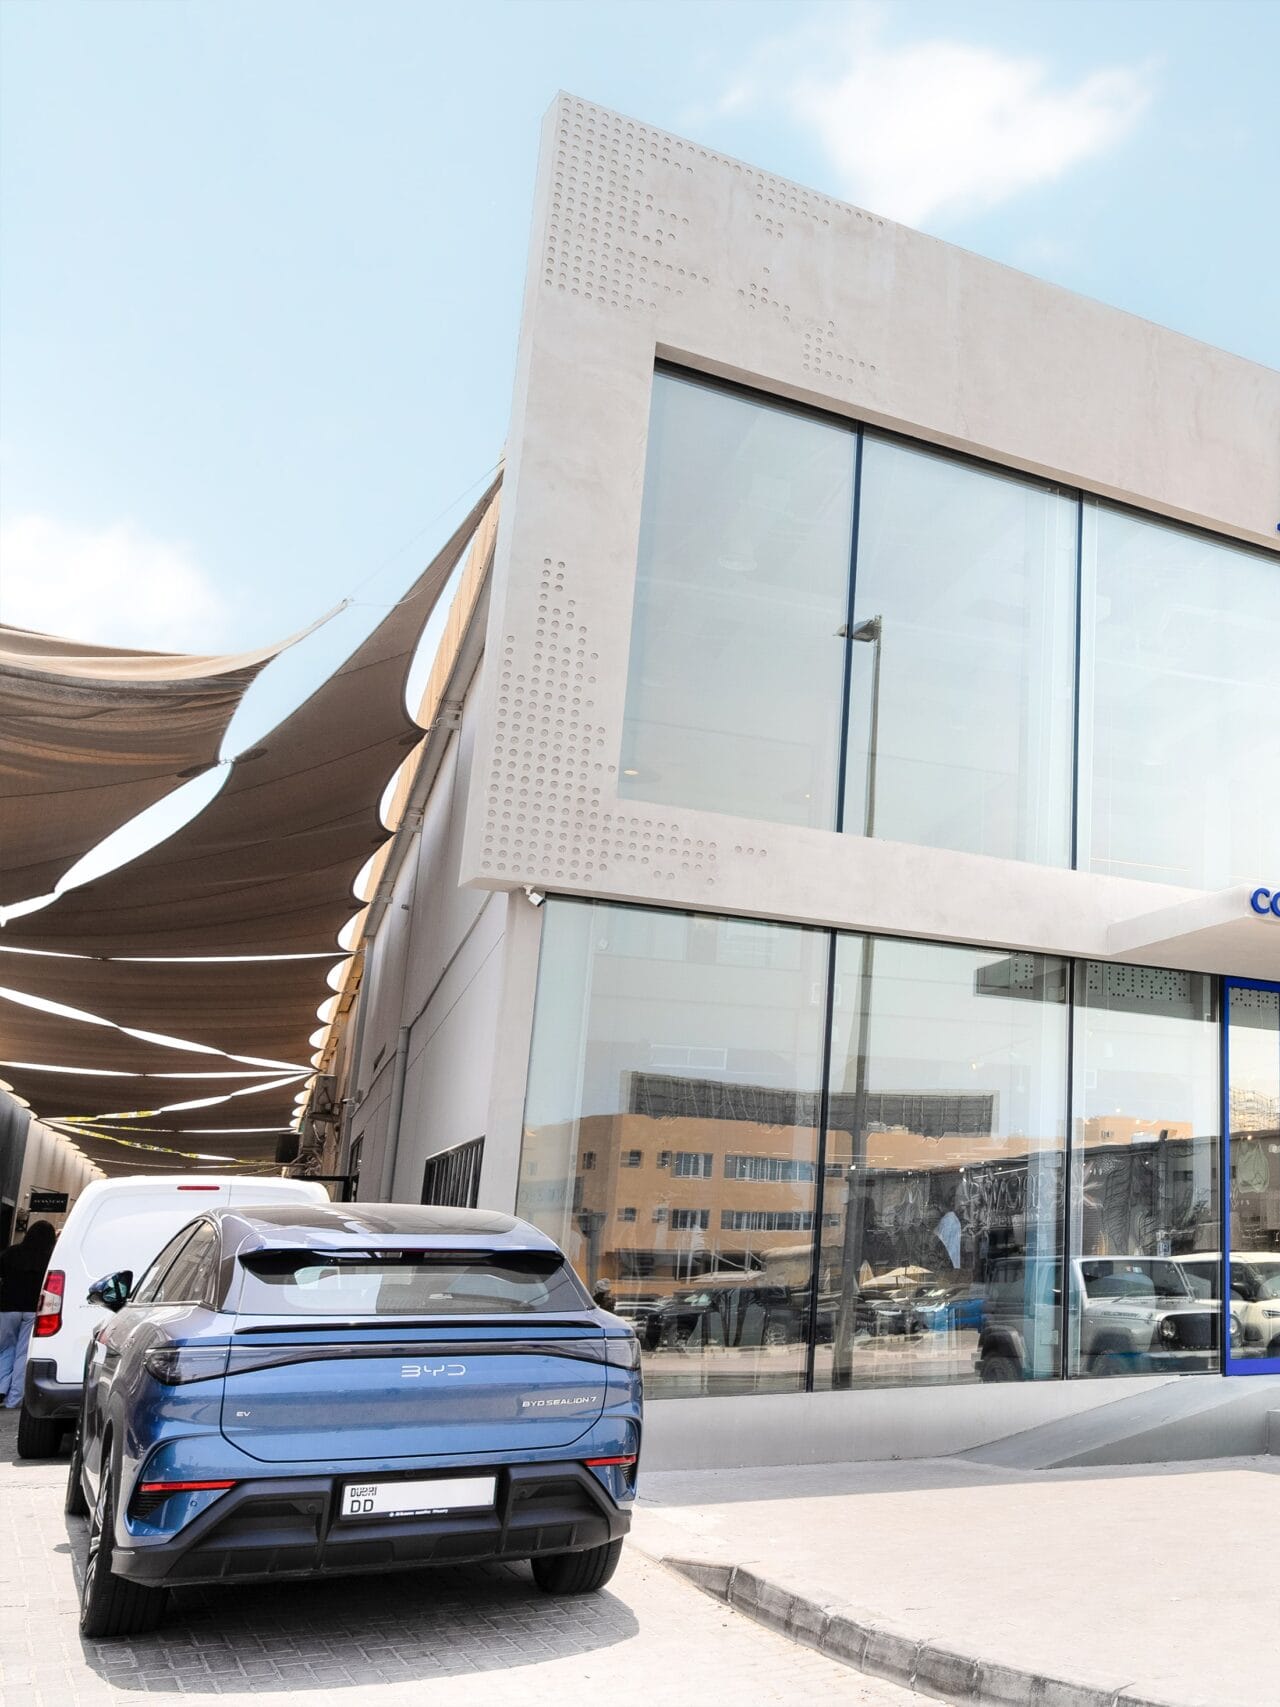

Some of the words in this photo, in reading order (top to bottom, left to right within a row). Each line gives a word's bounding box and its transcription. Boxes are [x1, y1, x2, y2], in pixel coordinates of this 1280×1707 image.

[401, 1364, 466, 1378] BYD
[522, 1400, 545, 1408] BYD
[546, 1396, 589, 1406] SEALION
